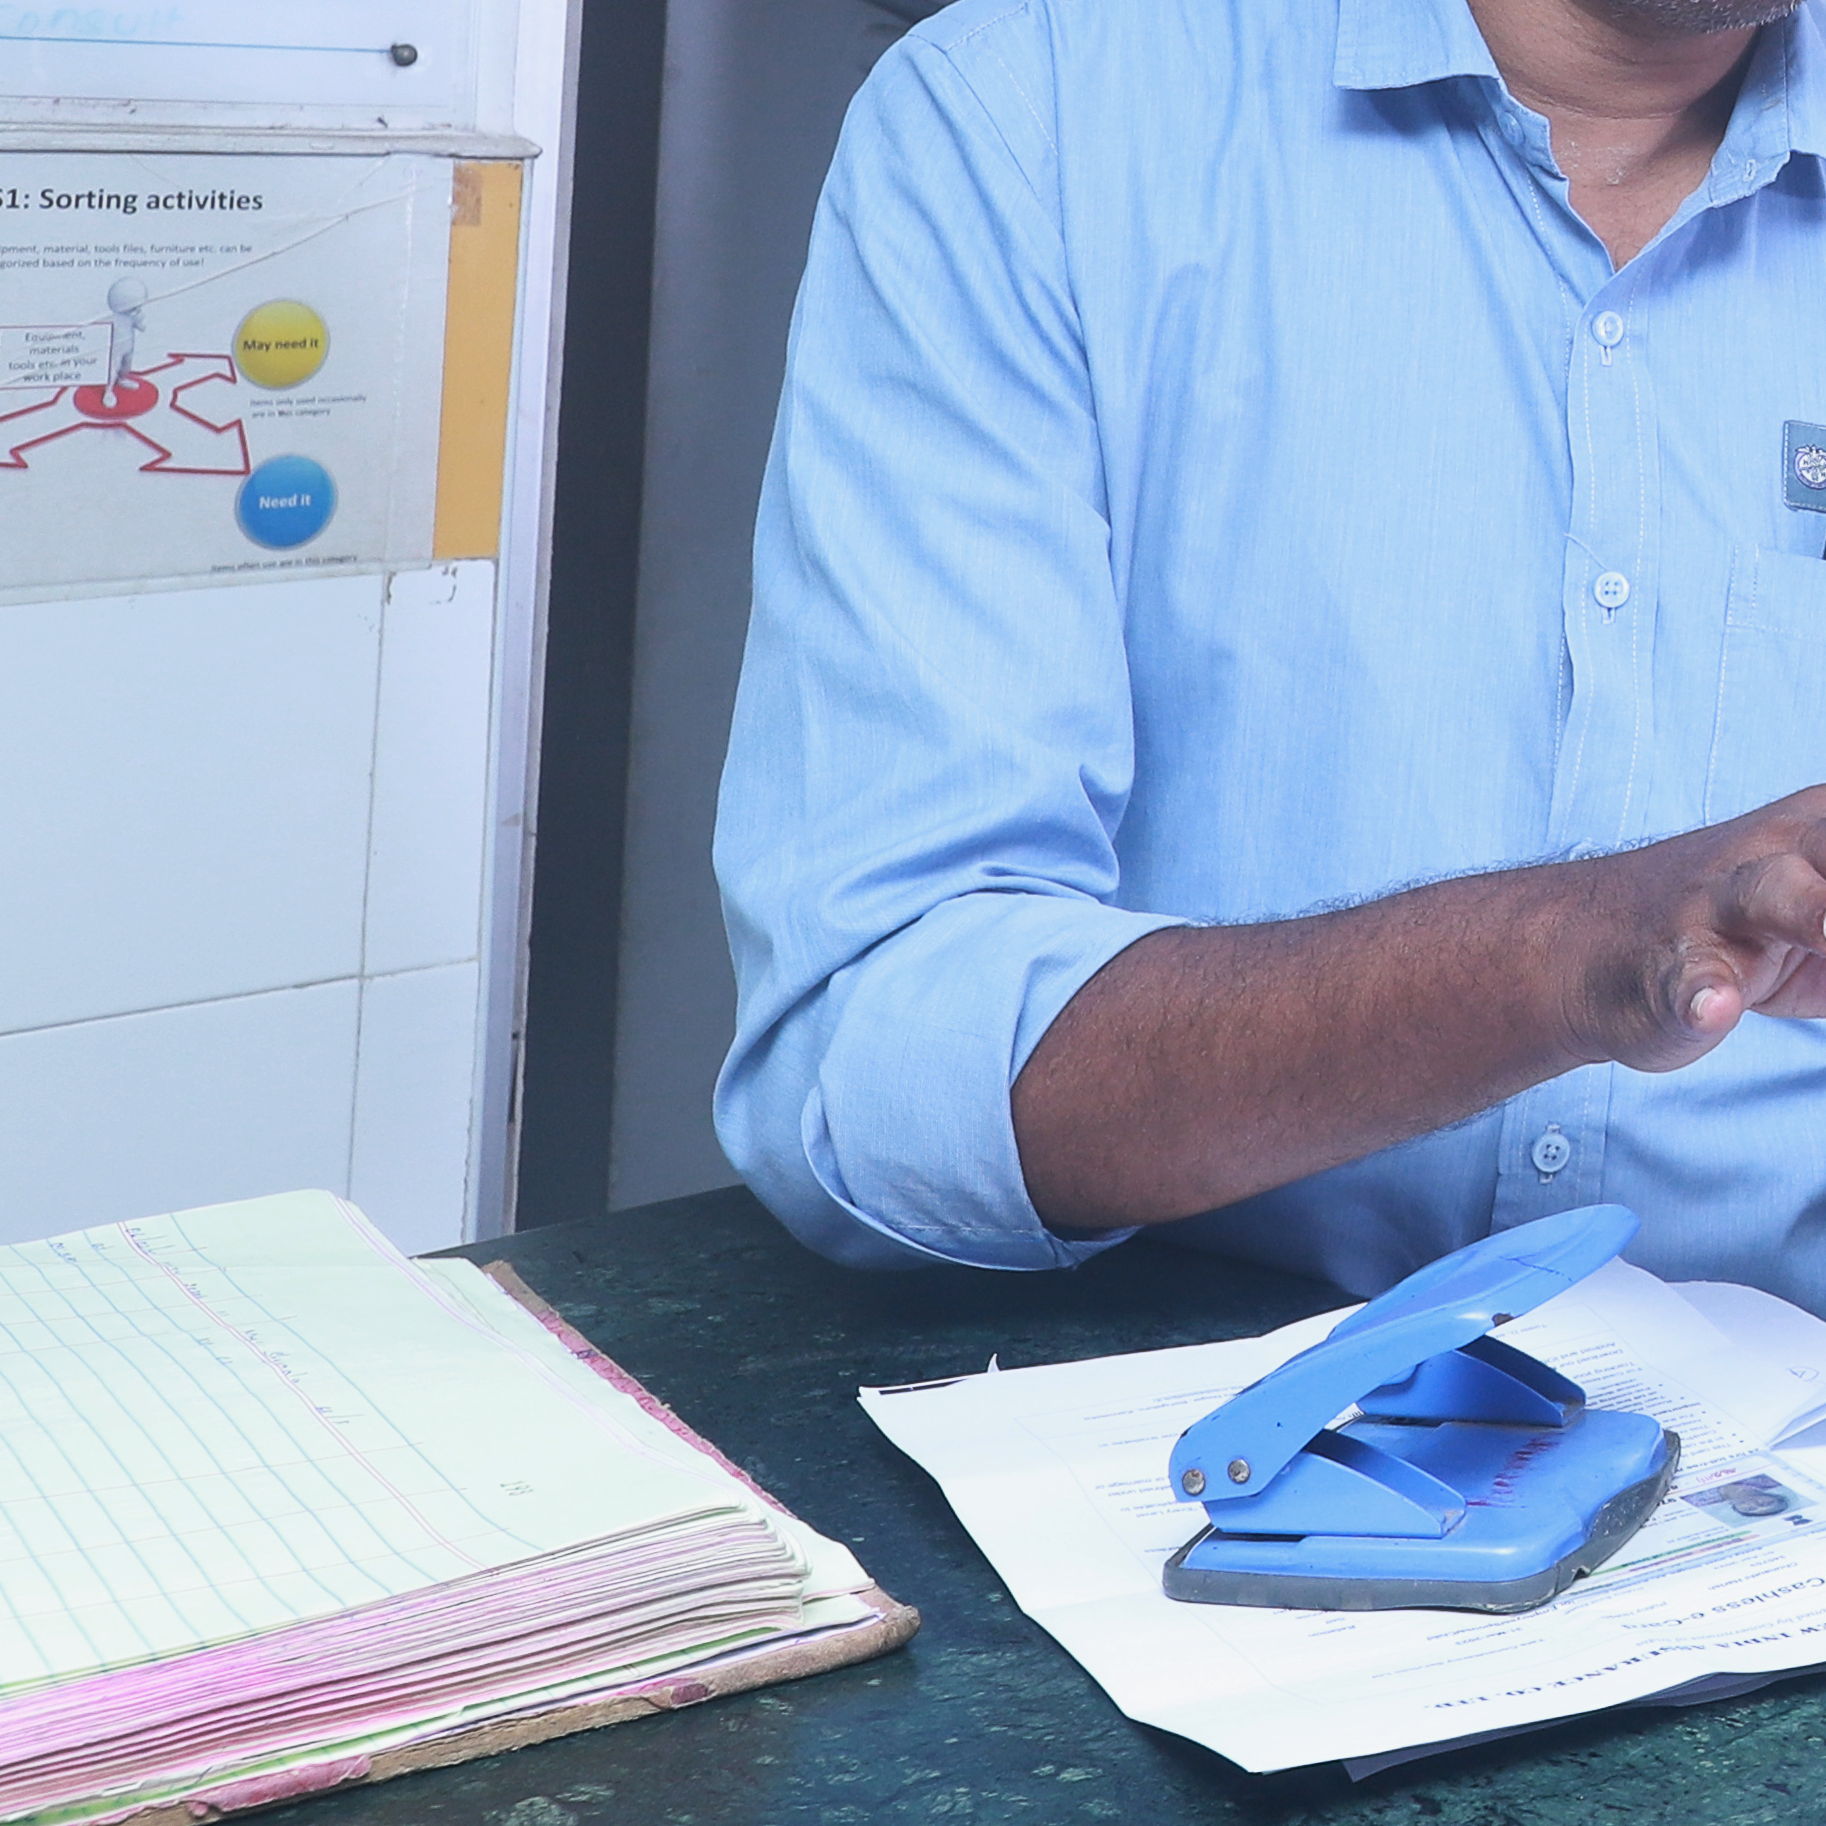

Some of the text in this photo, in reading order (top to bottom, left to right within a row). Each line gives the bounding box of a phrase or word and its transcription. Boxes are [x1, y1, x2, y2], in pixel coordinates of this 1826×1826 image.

[39, 188, 139, 214] Sorting
[146, 189, 263, 210] activities
[242, 337, 319, 352] May need it
[259, 492, 311, 508] Need it
[1710, 1576, 1826, 1614] Cashless
